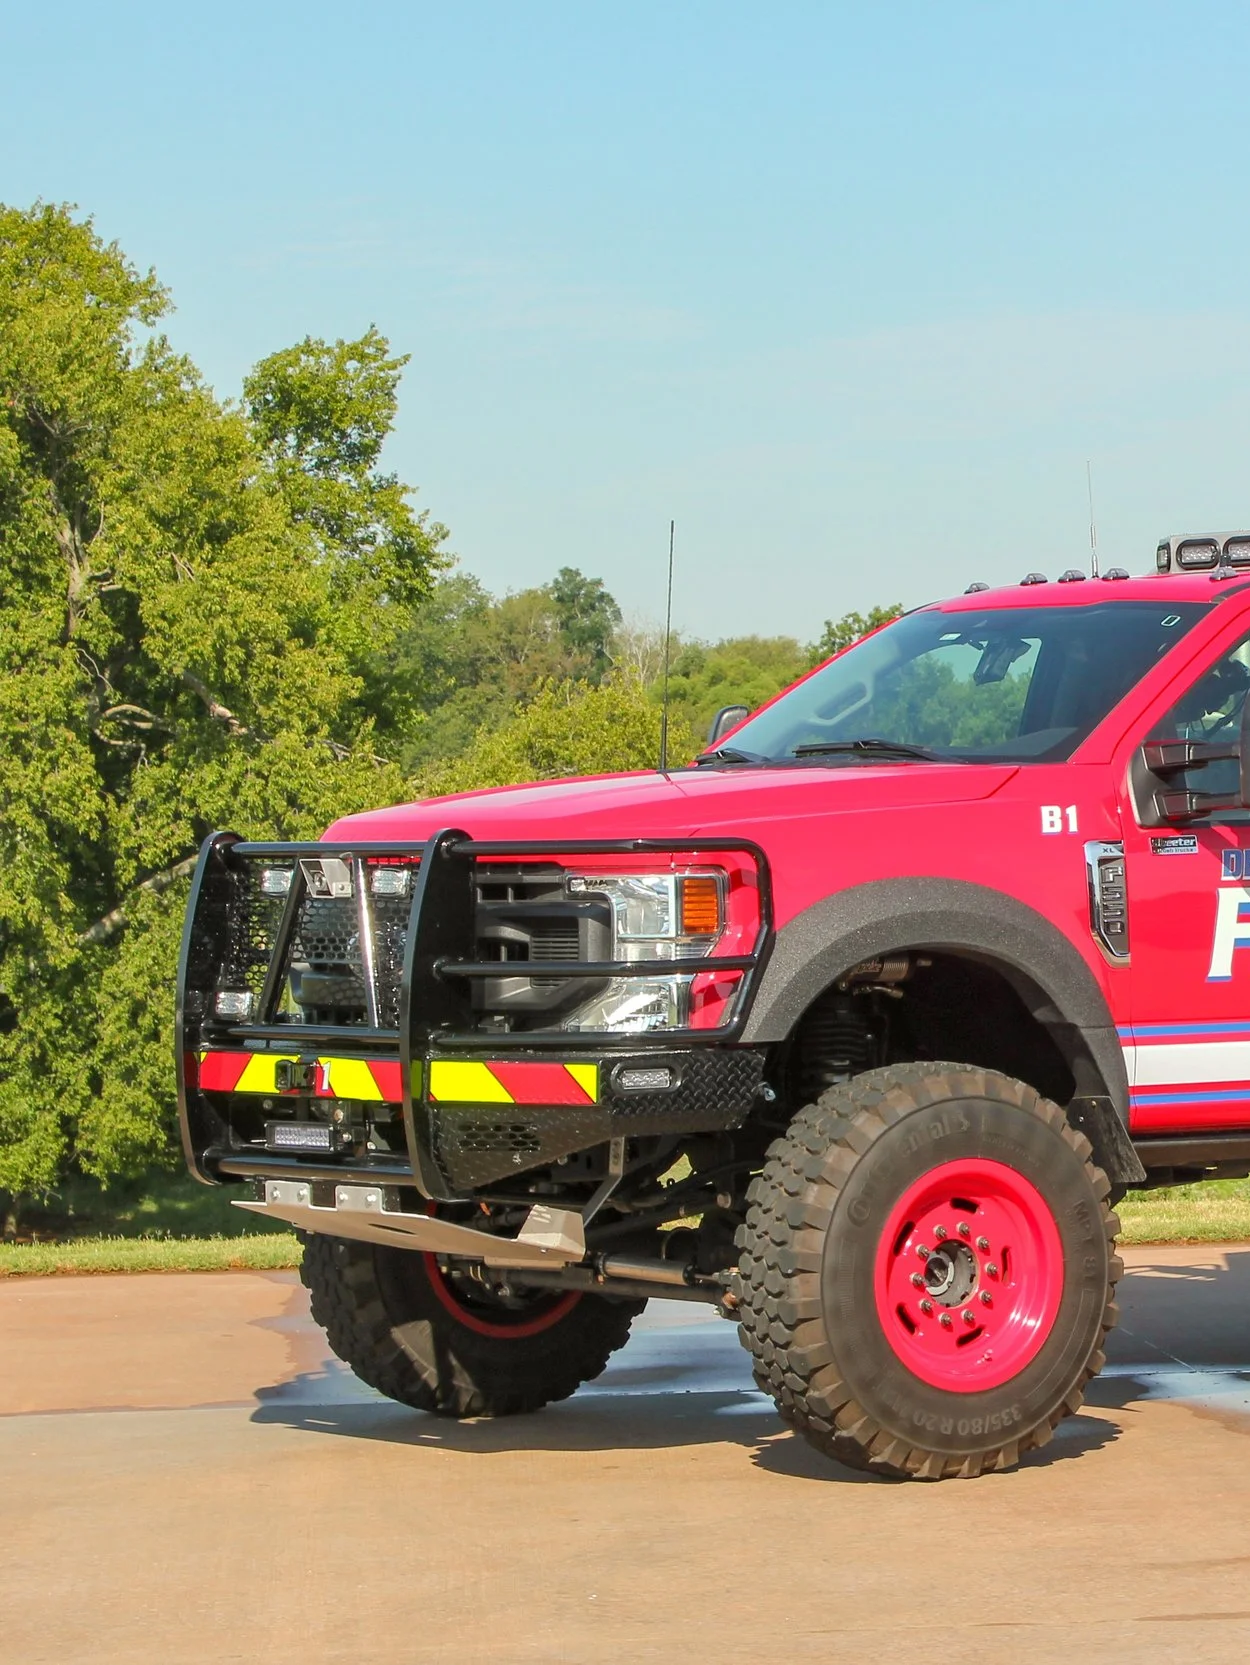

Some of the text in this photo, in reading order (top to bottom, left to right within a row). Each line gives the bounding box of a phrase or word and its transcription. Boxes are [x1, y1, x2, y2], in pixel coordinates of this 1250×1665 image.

[1040, 805, 1078, 834] B1
[1152, 837, 1197, 847] eeter
[913, 1409, 935, 1431] 20
[957, 1403, 1022, 1436] 335/80
